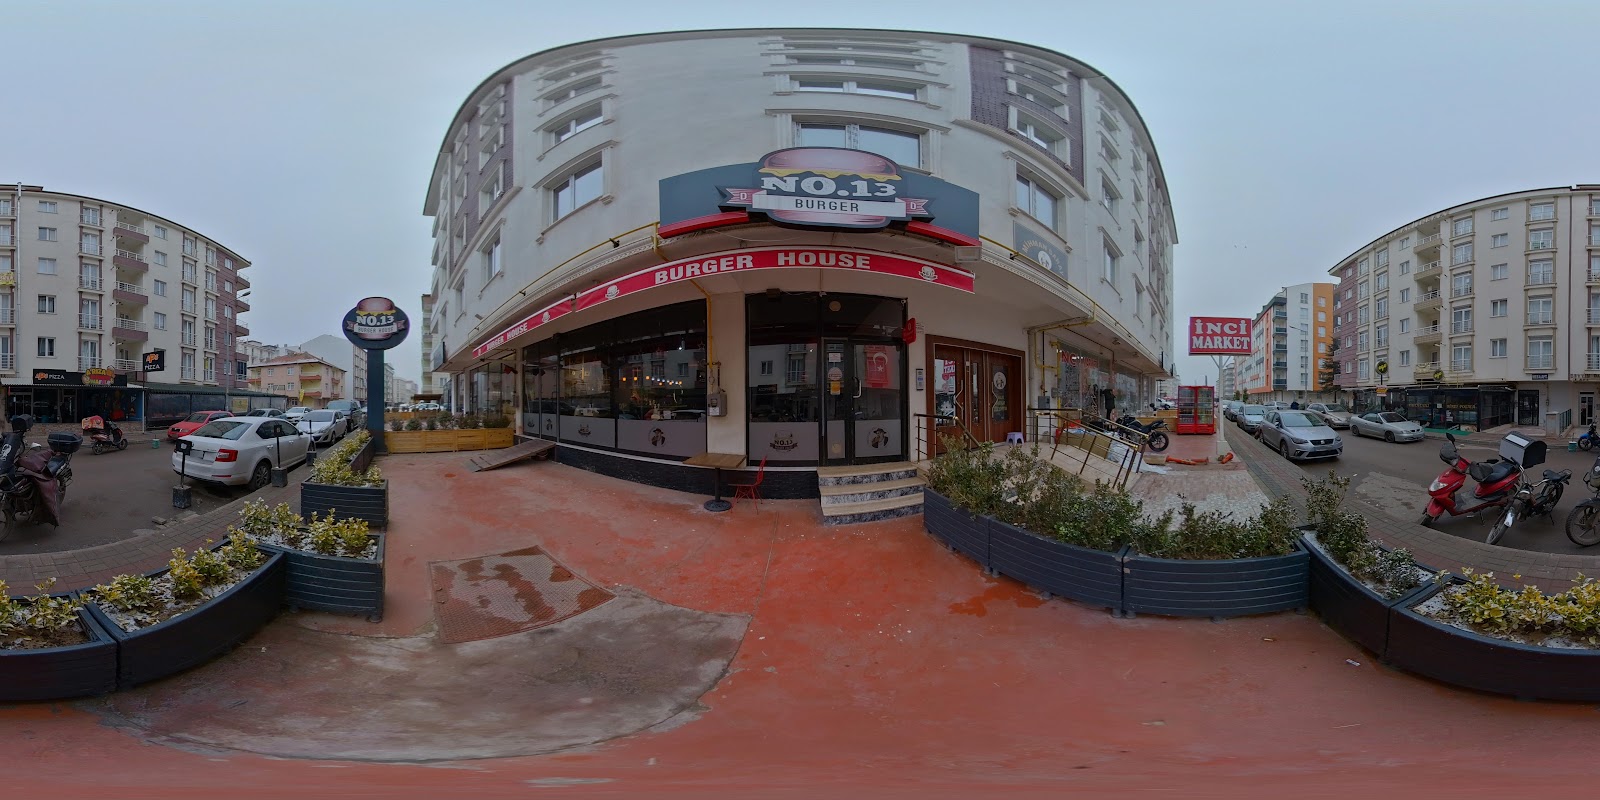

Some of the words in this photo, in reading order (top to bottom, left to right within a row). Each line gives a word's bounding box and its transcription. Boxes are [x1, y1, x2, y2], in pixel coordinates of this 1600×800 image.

[760, 176, 896, 196] NO.13
[795, 198, 859, 213] BURGER
[655, 254, 753, 285] BURGER
[777, 252, 871, 269] HOUSE
[356, 315, 395, 326] NO.13
[1194, 319, 1248, 335] İNCİ
[507, 322, 528, 339] HOUSE
[1191, 336, 1251, 350] MARKET
